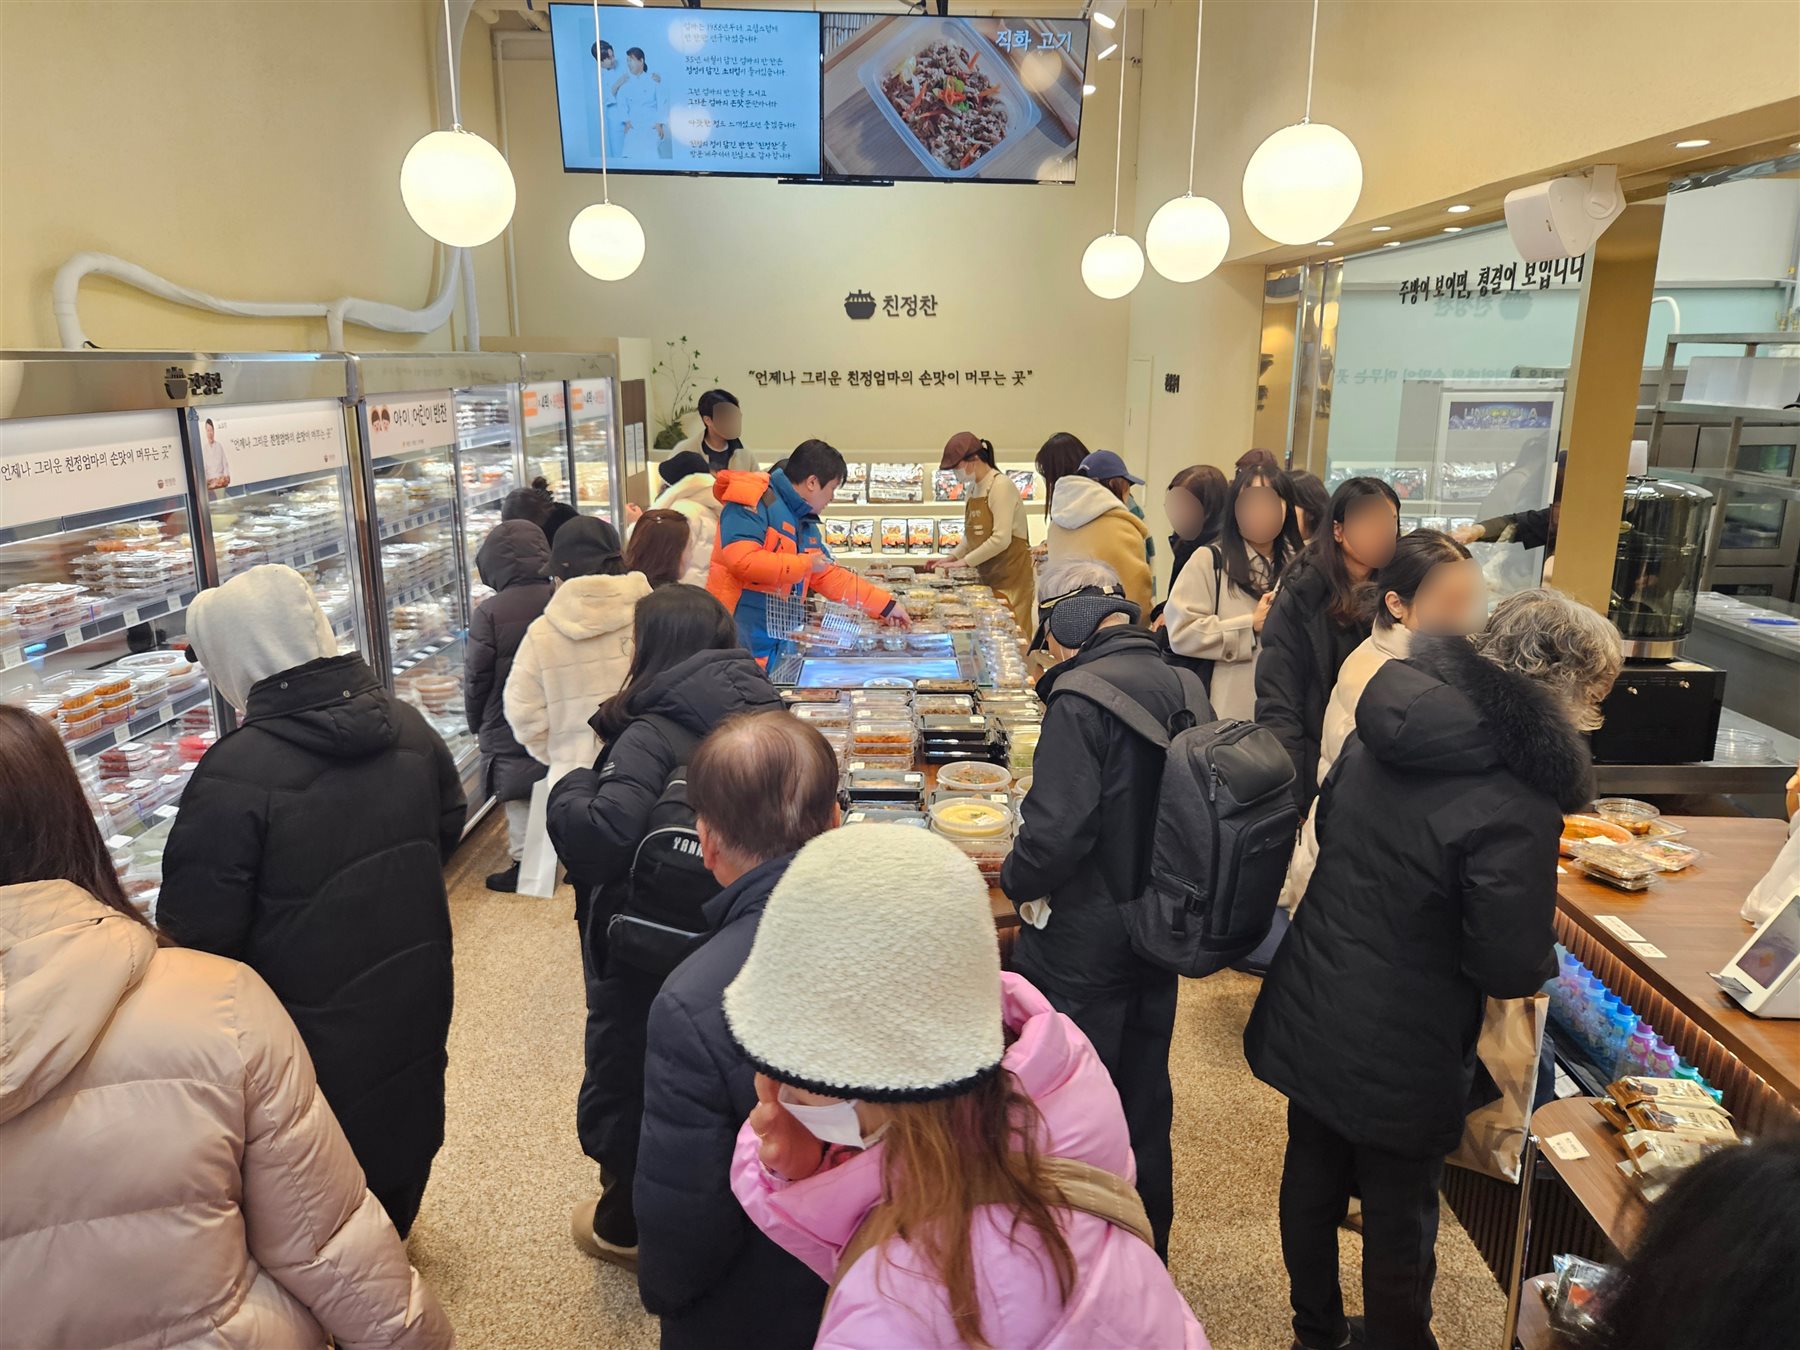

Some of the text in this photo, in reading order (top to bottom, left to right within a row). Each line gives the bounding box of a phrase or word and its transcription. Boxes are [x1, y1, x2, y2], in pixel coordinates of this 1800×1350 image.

[996, 30, 1073, 53] 직화 고기
[685, 55, 701, 64] 35년
[706, 66, 720, 75] 담긴
[709, 98, 728, 107] 엄마의
[723, 140, 736, 149] 담긴
[759, 151, 791, 160] 감사합니다
[1399, 276, 1430, 305] 주방이
[1433, 270, 1472, 299] 보이면,
[1477, 262, 1517, 297] 청결이
[882, 294, 938, 318] 친정찬
[749, 369, 1033, 387] "언제나 그리운 친정엄마의 손맛이 머무는 곳"
[413, 404, 433, 426] 어린이
[433, 402, 448, 424] 반찬
[1, 461, 32, 482] 언제나
[35, 457, 63, 475] 그리운
[65, 451, 108, 473] 친정엄마의
[110, 450, 134, 467] 손맛이
[136, 447, 160, 462] 머무는
